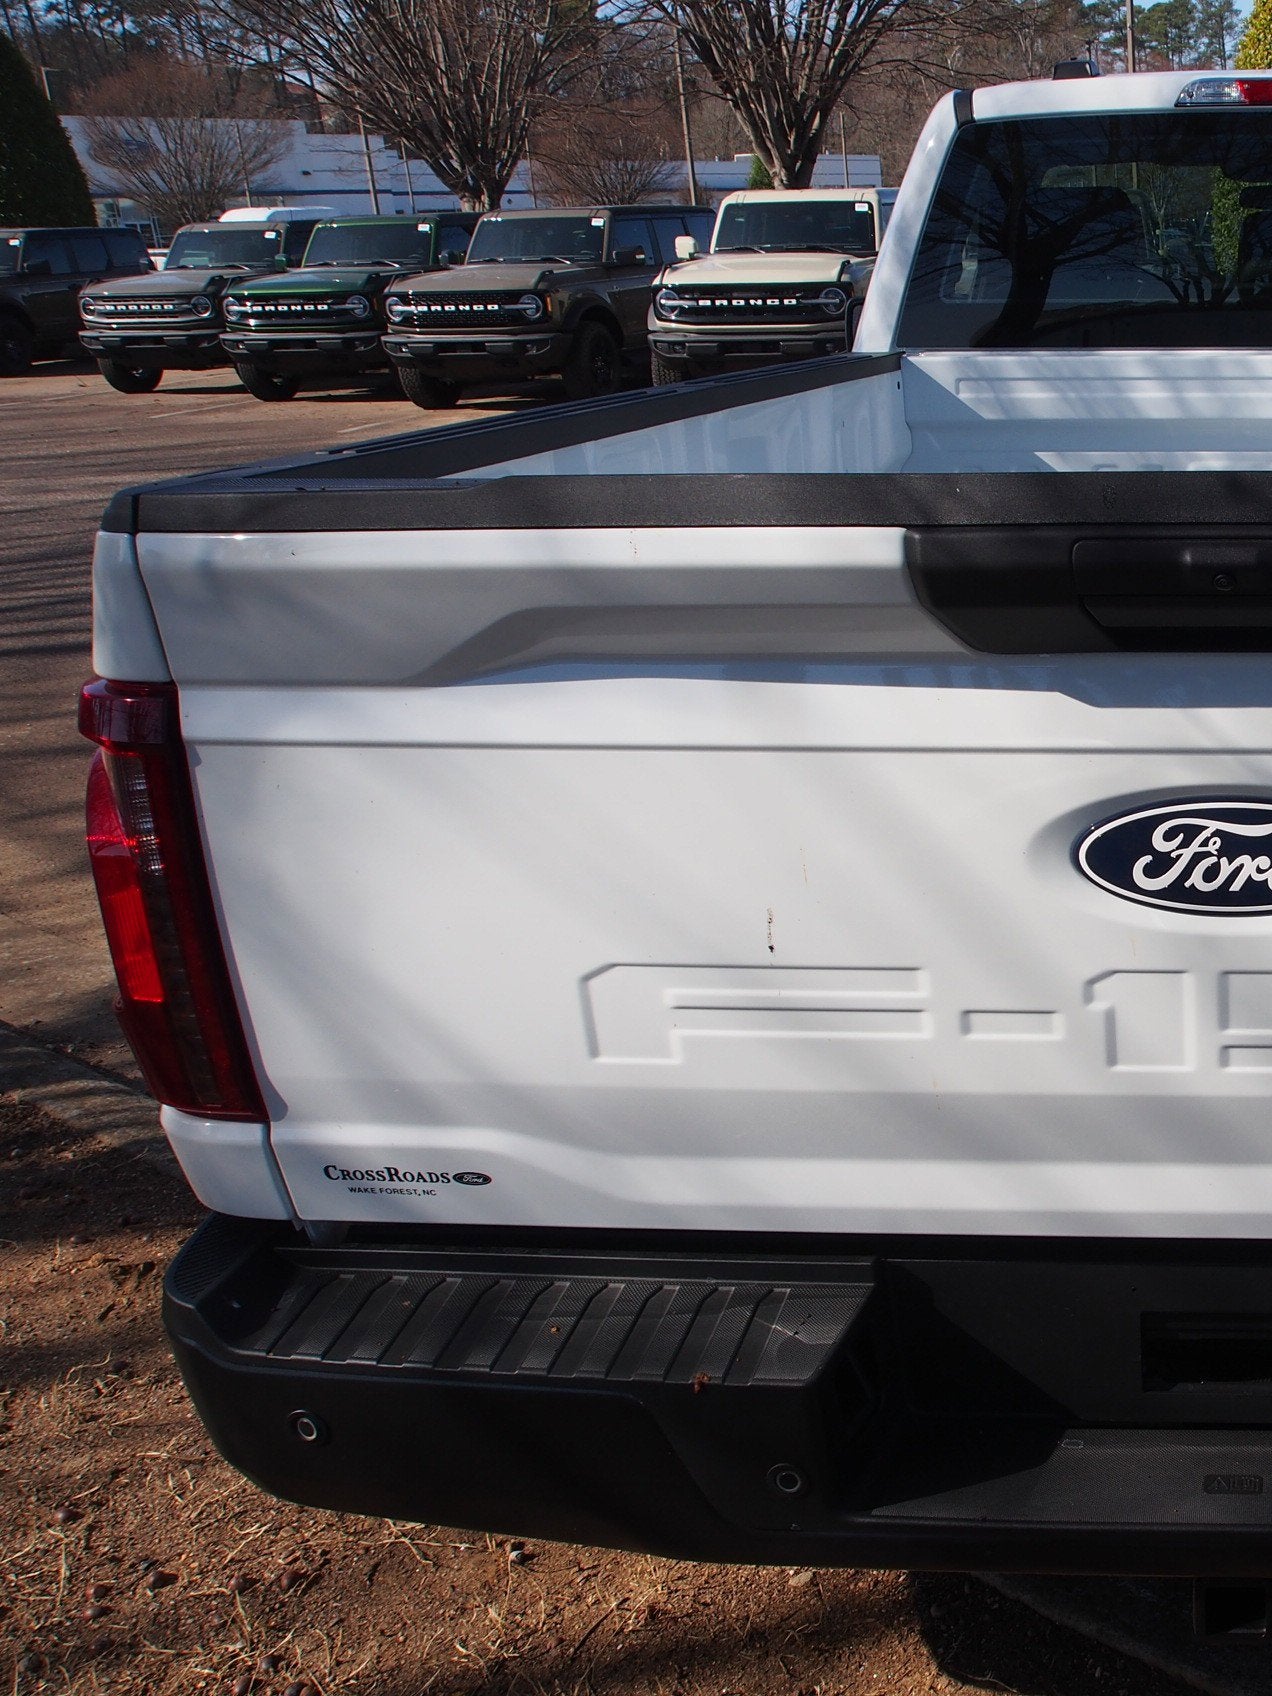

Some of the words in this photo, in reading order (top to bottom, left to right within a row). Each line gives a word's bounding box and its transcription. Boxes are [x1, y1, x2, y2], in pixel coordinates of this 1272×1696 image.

[698, 298, 797, 306] BRONCO
[348, 1186, 376, 1194] WAKE
[379, 1187, 421, 1196] FOREST,
[423, 1188, 437, 1196] NC
